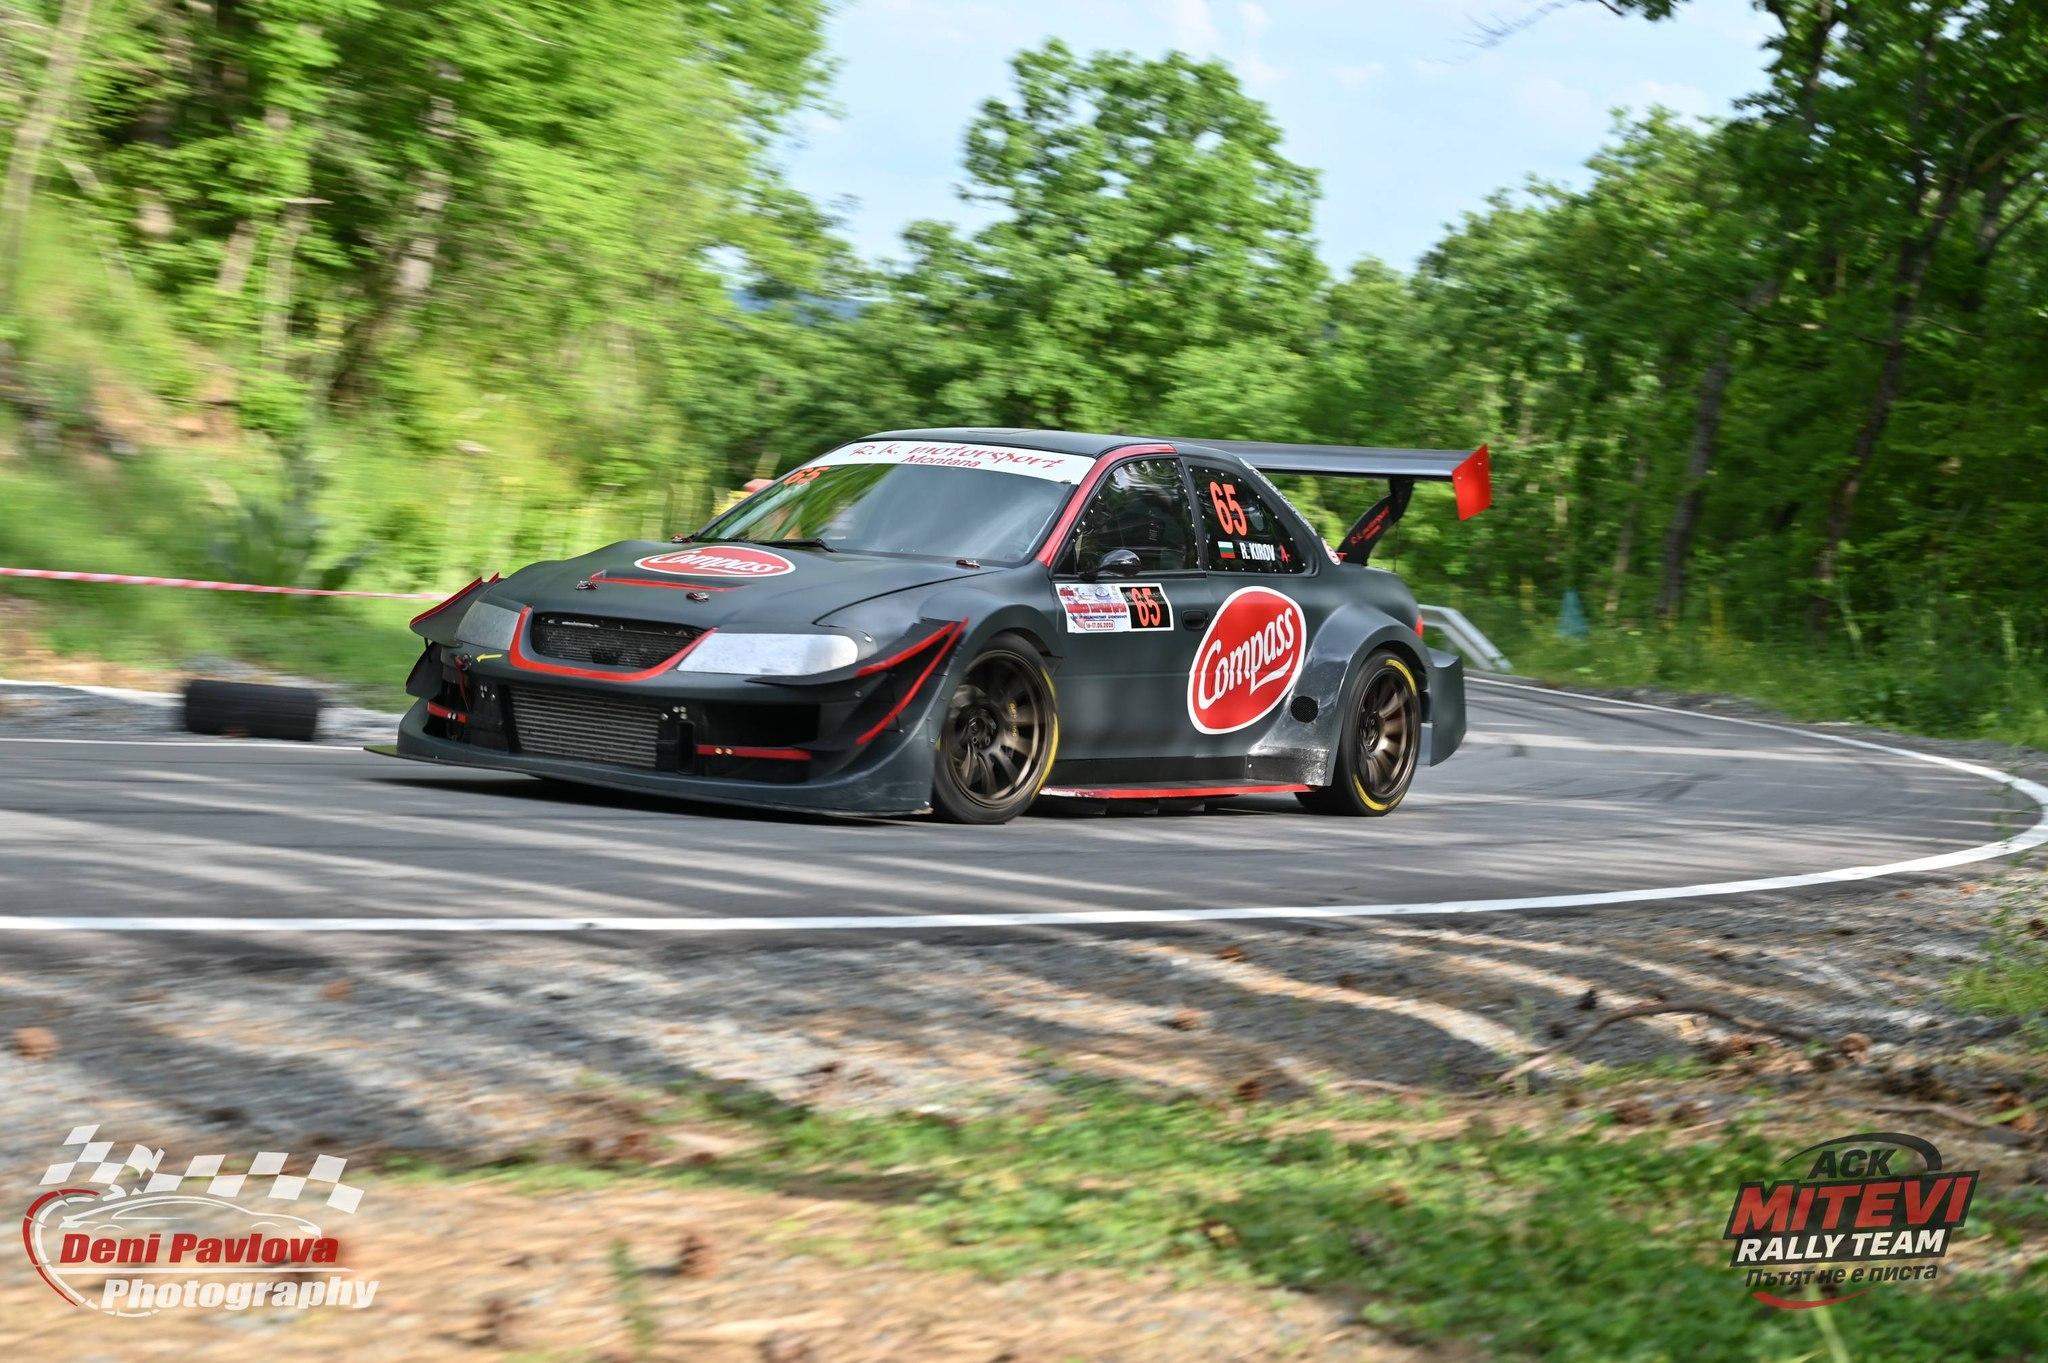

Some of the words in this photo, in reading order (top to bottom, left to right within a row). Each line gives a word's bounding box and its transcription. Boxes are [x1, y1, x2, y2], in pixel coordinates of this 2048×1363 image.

[900, 455, 981, 467] Montana
[783, 467, 831, 486] 65
[1209, 481, 1248, 536] 65
[648, 550, 784, 574] Compass
[1249, 543, 1276, 561] KIROV
[1131, 588, 1161, 626] 65
[1198, 607, 1294, 710] Compass
